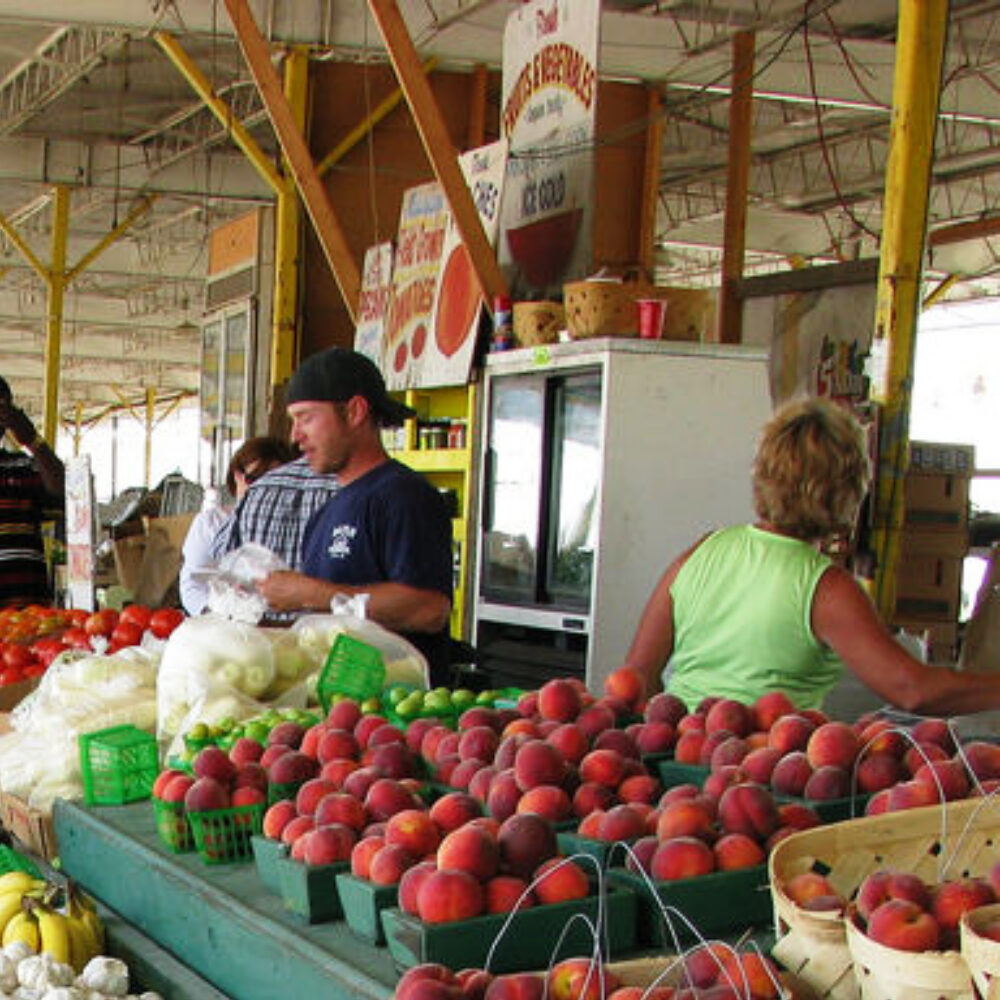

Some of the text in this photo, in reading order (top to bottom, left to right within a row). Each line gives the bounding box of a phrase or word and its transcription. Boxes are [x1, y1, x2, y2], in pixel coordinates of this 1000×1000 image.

[541, 42, 596, 110] VEGETABLES
[473, 181, 498, 221] CHES
[522, 172, 565, 217] ICE COLD
